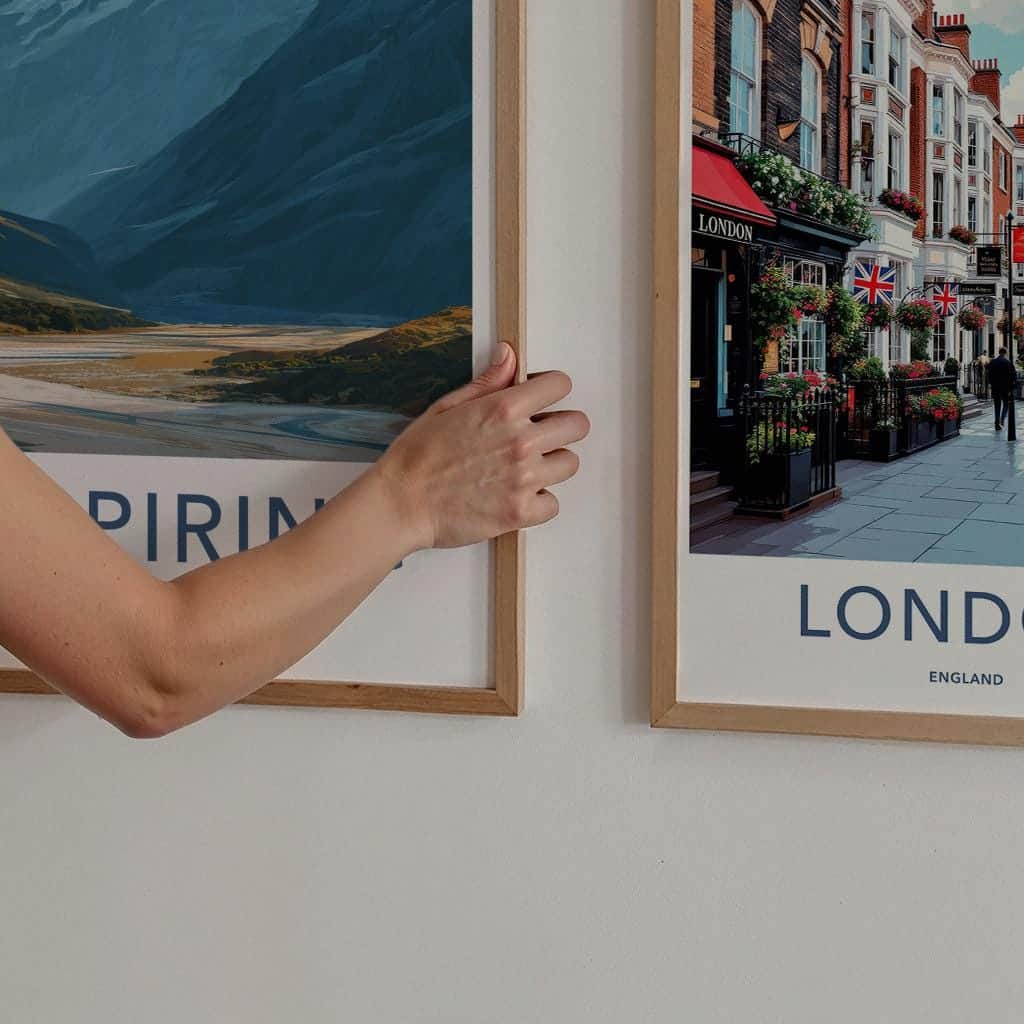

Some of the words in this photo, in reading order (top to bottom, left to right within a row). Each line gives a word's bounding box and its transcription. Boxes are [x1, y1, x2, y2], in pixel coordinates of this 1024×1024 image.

[699, 213, 753, 241] LONDON
[800, 583, 1024, 645] LOND
[929, 670, 1005, 686] ENGLAND
